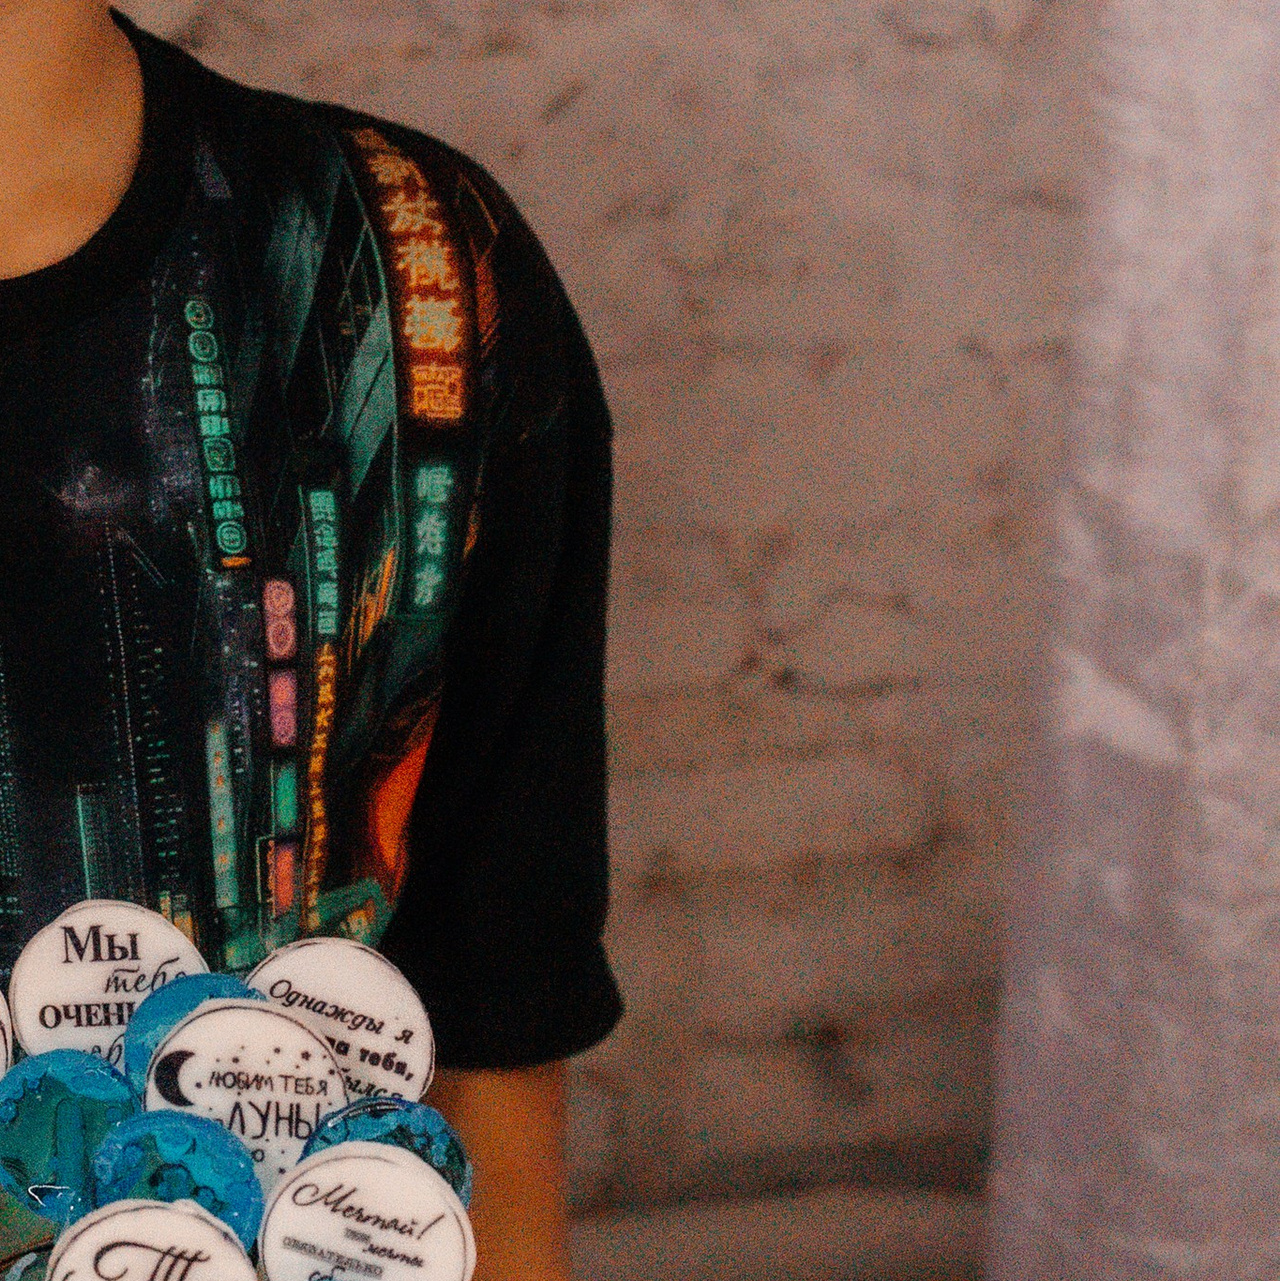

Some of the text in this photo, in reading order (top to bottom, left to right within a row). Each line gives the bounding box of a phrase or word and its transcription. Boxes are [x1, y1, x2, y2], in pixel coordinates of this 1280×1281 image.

[60, 924, 141, 964] Мы
[270, 979, 415, 1045] Однажды я
[279, 1074, 328, 1096] ТЕБЯ
[227, 1101, 321, 1140] ЛУНЫ
[292, 1183, 446, 1240] Мечтай!
